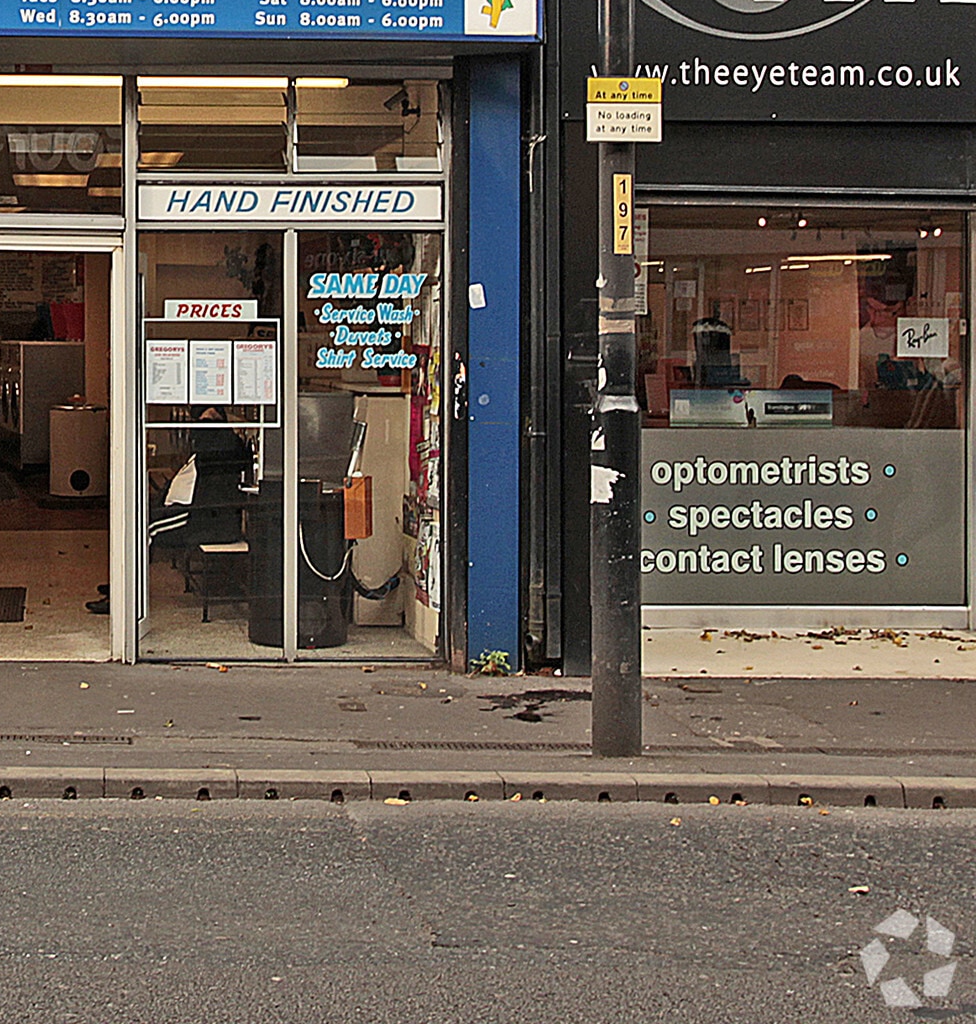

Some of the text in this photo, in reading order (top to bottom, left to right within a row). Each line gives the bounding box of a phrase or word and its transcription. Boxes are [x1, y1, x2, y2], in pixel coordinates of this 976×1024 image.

[20, 9, 56, 23] Wed
[69, 10, 131, 26] 8.30am
[153, 11, 215, 27] 6.00pm
[255, 11, 286, 25] Sun
[300, 11, 361, 26] 8.00am
[381, 12, 444, 29] 6.00pm
[591, 58, 961, 93] w.theeyeteam.co.uk
[595, 91, 653, 100] At any time
[597, 111, 651, 121] No loading
[595, 124, 652, 134] at any time
[166, 190, 416, 213] HAND FINISHED
[307, 273, 429, 299] SAME DAY
[176, 303, 243, 318] PRICES
[319, 302, 414, 325] Service Wash
[333, 326, 392, 345] Duvets
[315, 347, 418, 368] Shirt Service
[650, 456, 870, 492] optometrists
[667, 501, 855, 536] spectacles
[640, 543, 886, 573] contact lenses
